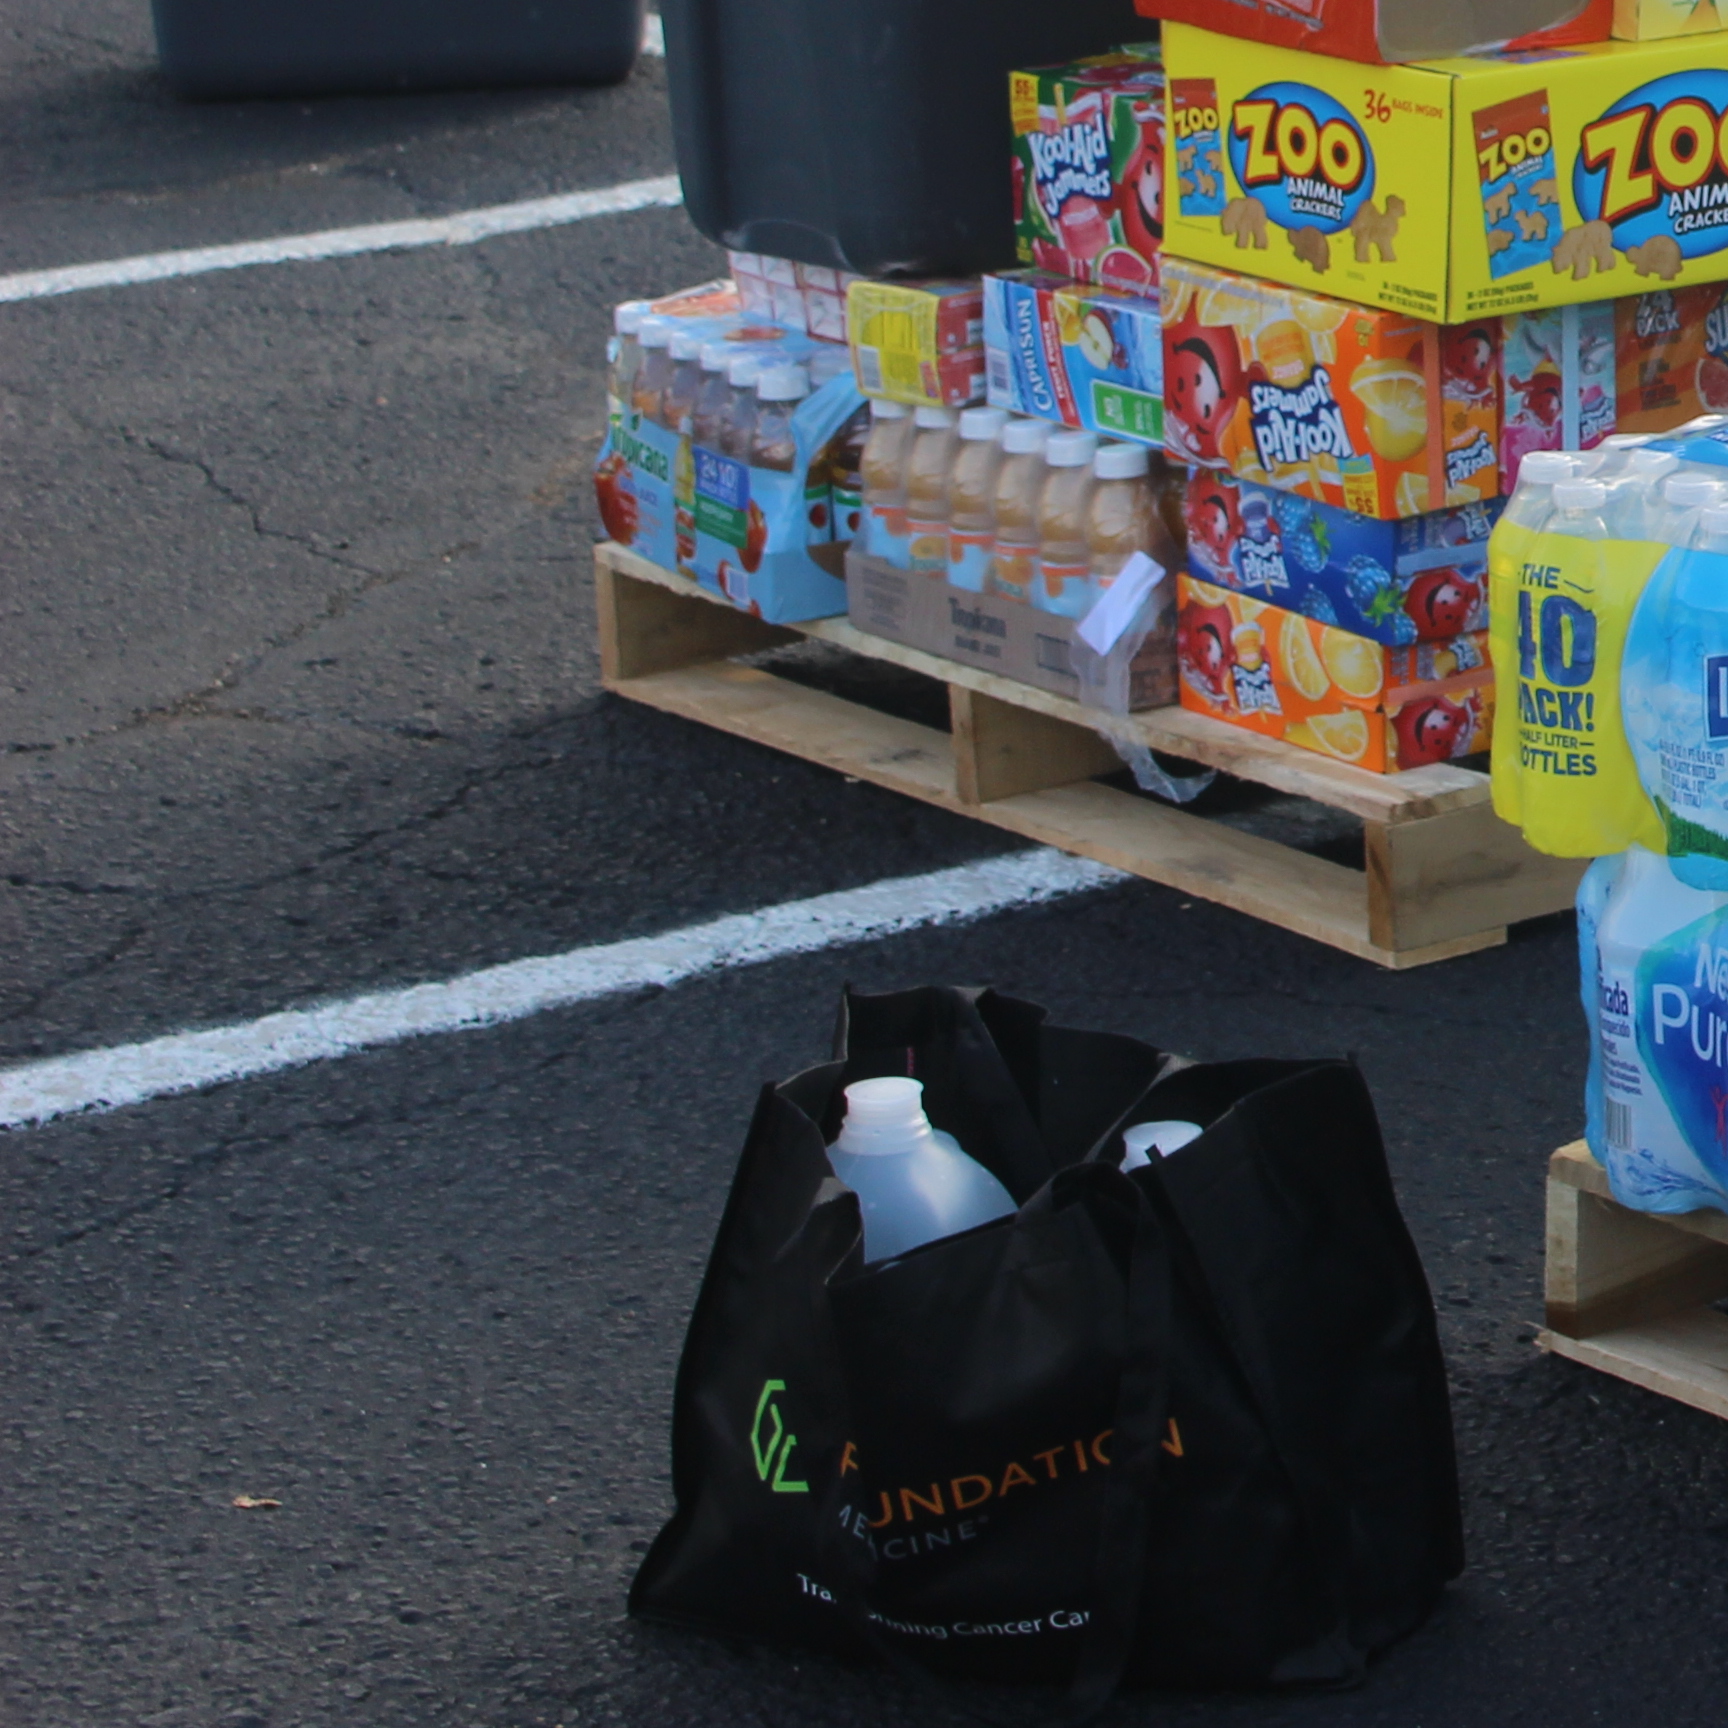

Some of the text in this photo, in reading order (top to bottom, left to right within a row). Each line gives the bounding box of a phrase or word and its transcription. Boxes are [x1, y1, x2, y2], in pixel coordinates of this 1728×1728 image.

[1174, 107, 1219, 140] ZOO
[1363, 88, 1392, 124] 36
[1027, 110, 1109, 180] Kool-Aid
[1232, 99, 1367, 189] ZOO
[1477, 126, 1551, 184] ZOO
[1043, 168, 1111, 216] Jammers
[1286, 176, 1345, 207] ANIMAL
[1289, 196, 1343, 222] CRACKERS
[1250, 366, 1331, 414] Jammers
[1256, 406, 1354, 473] Kool-Aid
[1519, 563, 1560, 589] THE
[1518, 594, 1598, 688] 40
[1550, 732, 1579, 750] LITER
[952, 1617, 1042, 1636] Cancer
